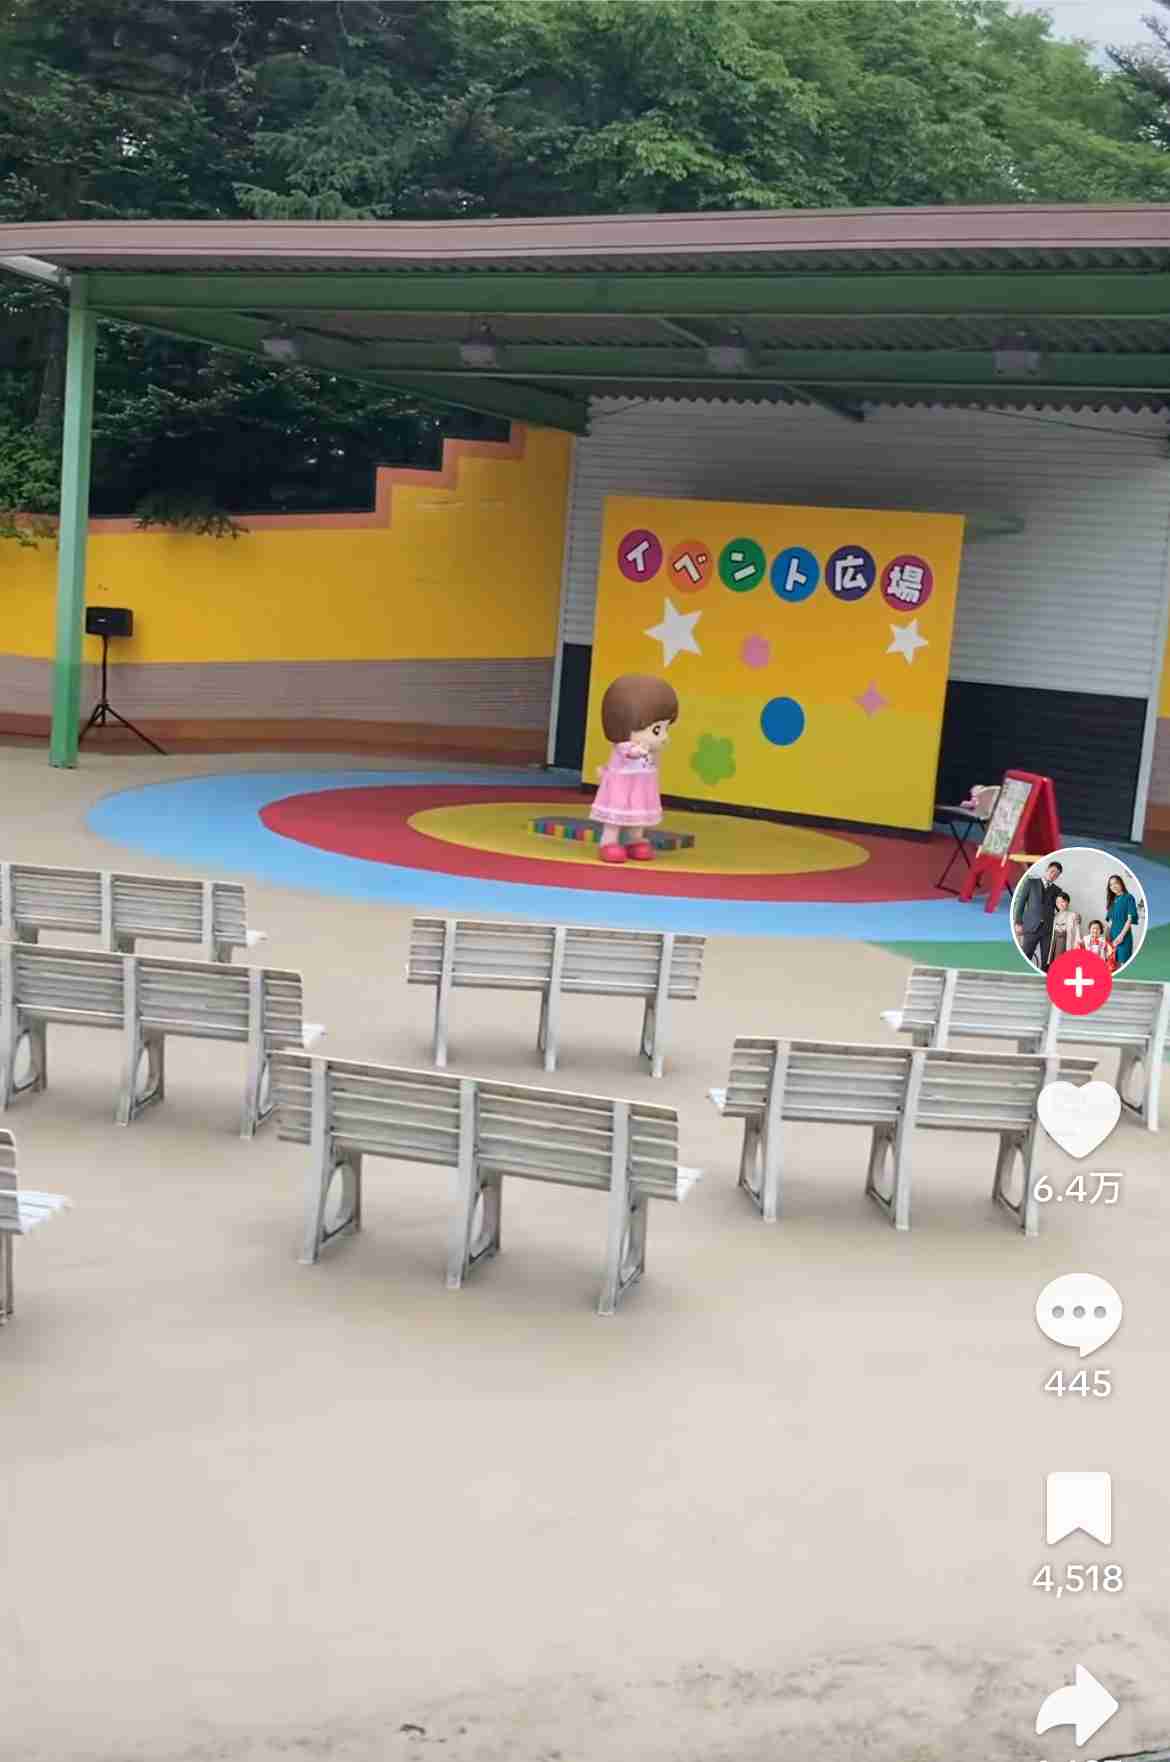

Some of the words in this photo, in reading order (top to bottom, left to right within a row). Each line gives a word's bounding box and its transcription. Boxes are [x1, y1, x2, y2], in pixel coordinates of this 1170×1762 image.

[625, 540, 925, 603] イベント広場
